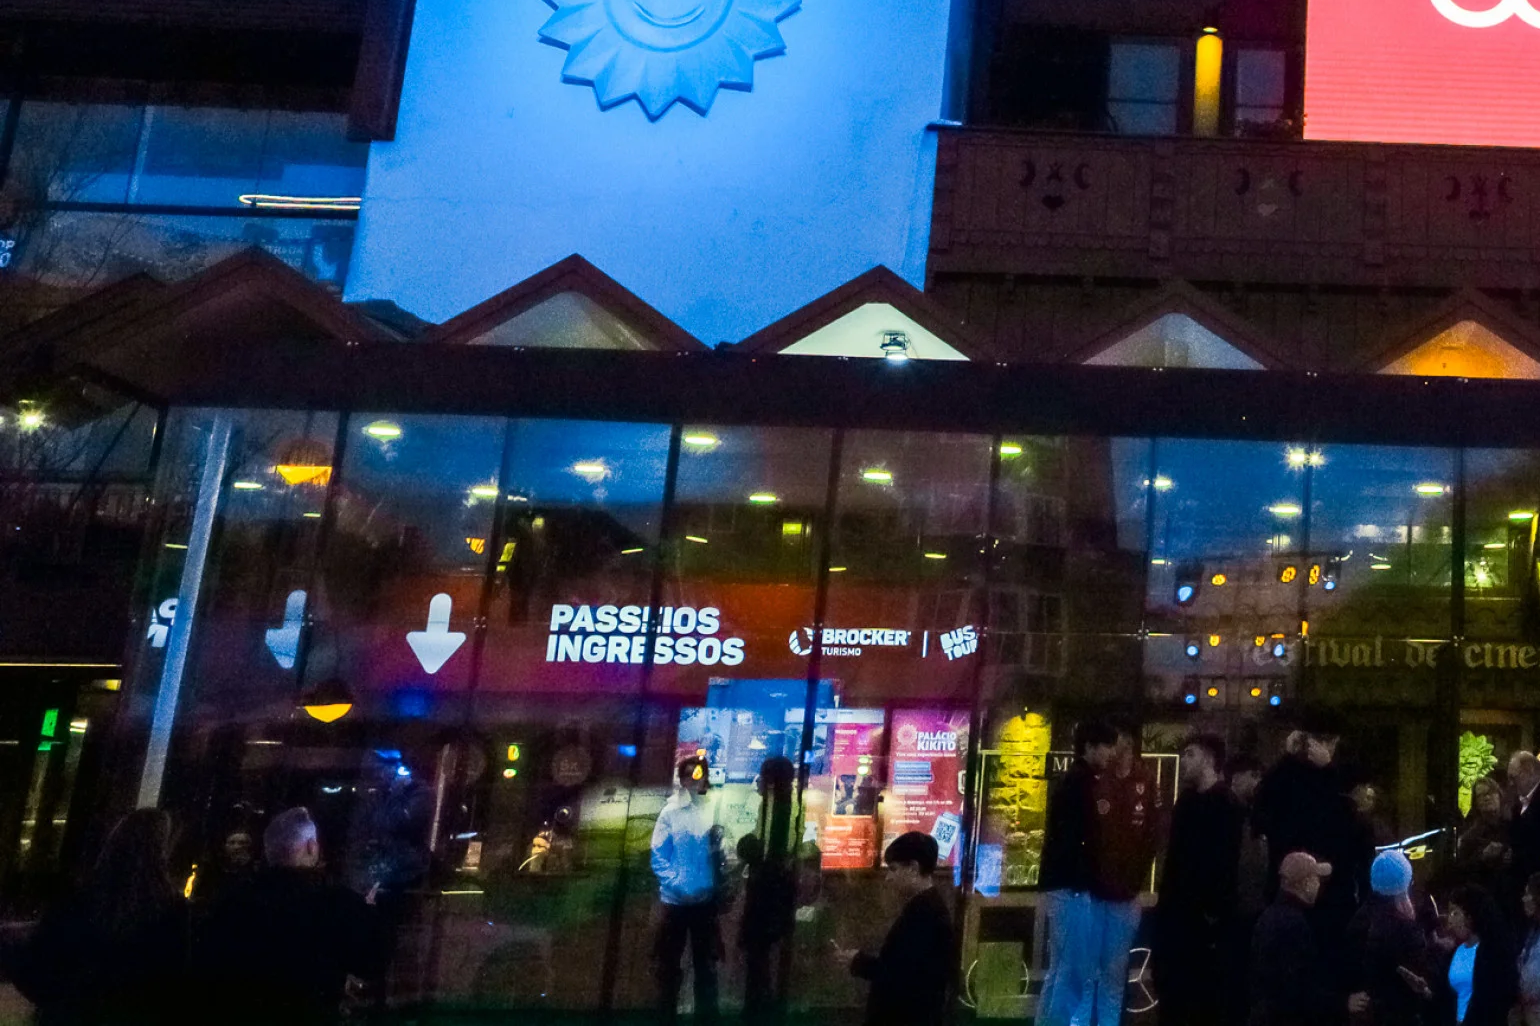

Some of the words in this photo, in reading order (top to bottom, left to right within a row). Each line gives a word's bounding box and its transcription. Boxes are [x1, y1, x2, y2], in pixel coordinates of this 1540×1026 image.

[821, 628, 907, 646] BROCKER
[940, 625, 976, 648] BUS
[546, 635, 745, 666] INGRESSOS
[821, 647, 862, 656] TURISMO
[917, 730, 957, 740] PALÁCIO
[917, 741, 957, 751] KIKITO
